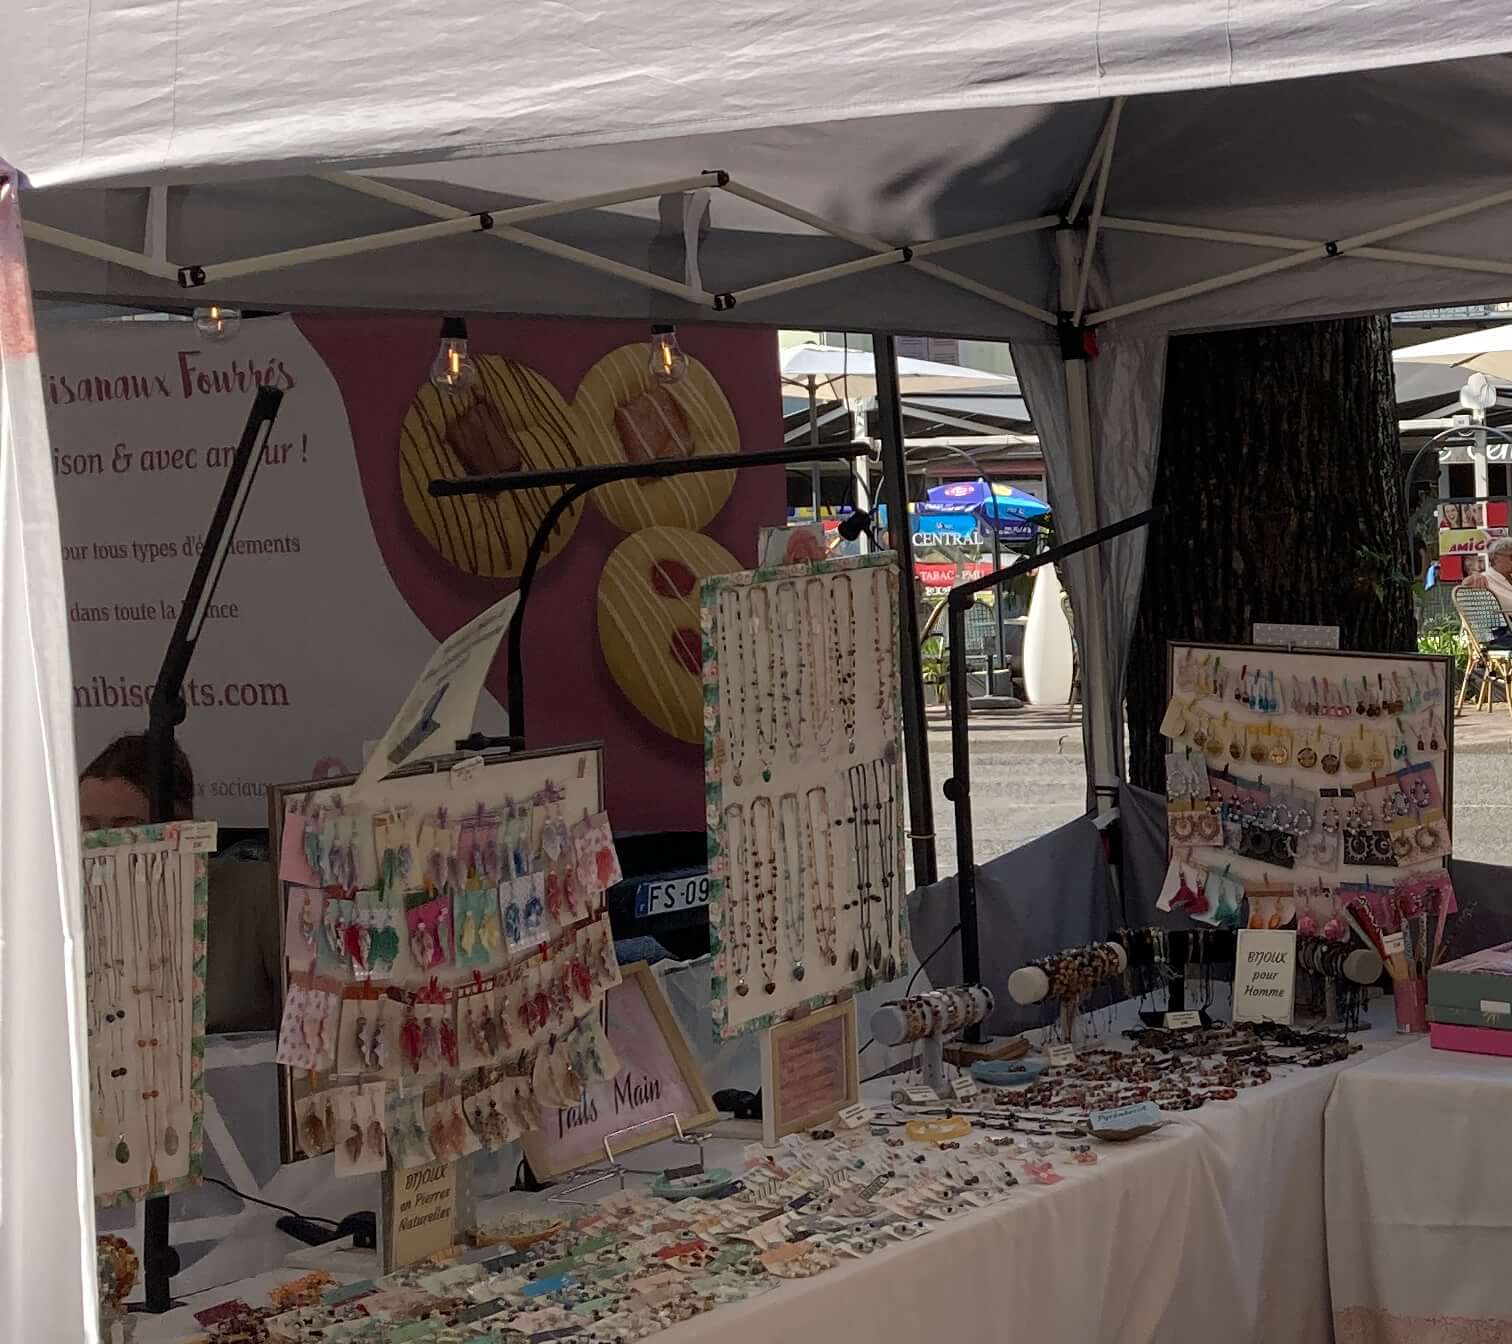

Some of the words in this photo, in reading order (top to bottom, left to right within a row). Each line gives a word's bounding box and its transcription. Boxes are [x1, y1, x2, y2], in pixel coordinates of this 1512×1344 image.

[43, 372, 171, 407] isanaux
[53, 447, 104, 476] ison
[112, 442, 133, 474] &
[140, 447, 198, 472] avec
[92, 542, 129, 560] tous
[132, 538, 178, 564] types
[911, 532, 984, 547] CENTRAL
[919, 569, 955, 582] TABAC
[70, 601, 110, 623] dans
[113, 603, 157, 621] toute
[160, 599, 177, 621] la
[1247, 951, 1288, 966] BIJOUX
[1251, 971, 1279, 983] pour
[1244, 985, 1286, 997] Homme
[614, 1072, 662, 1115] Main
[405, 1163, 449, 1192] BIJOUX
[415, 1188, 451, 1208] Pierres
[399, 1207, 452, 1233] Naturelles
